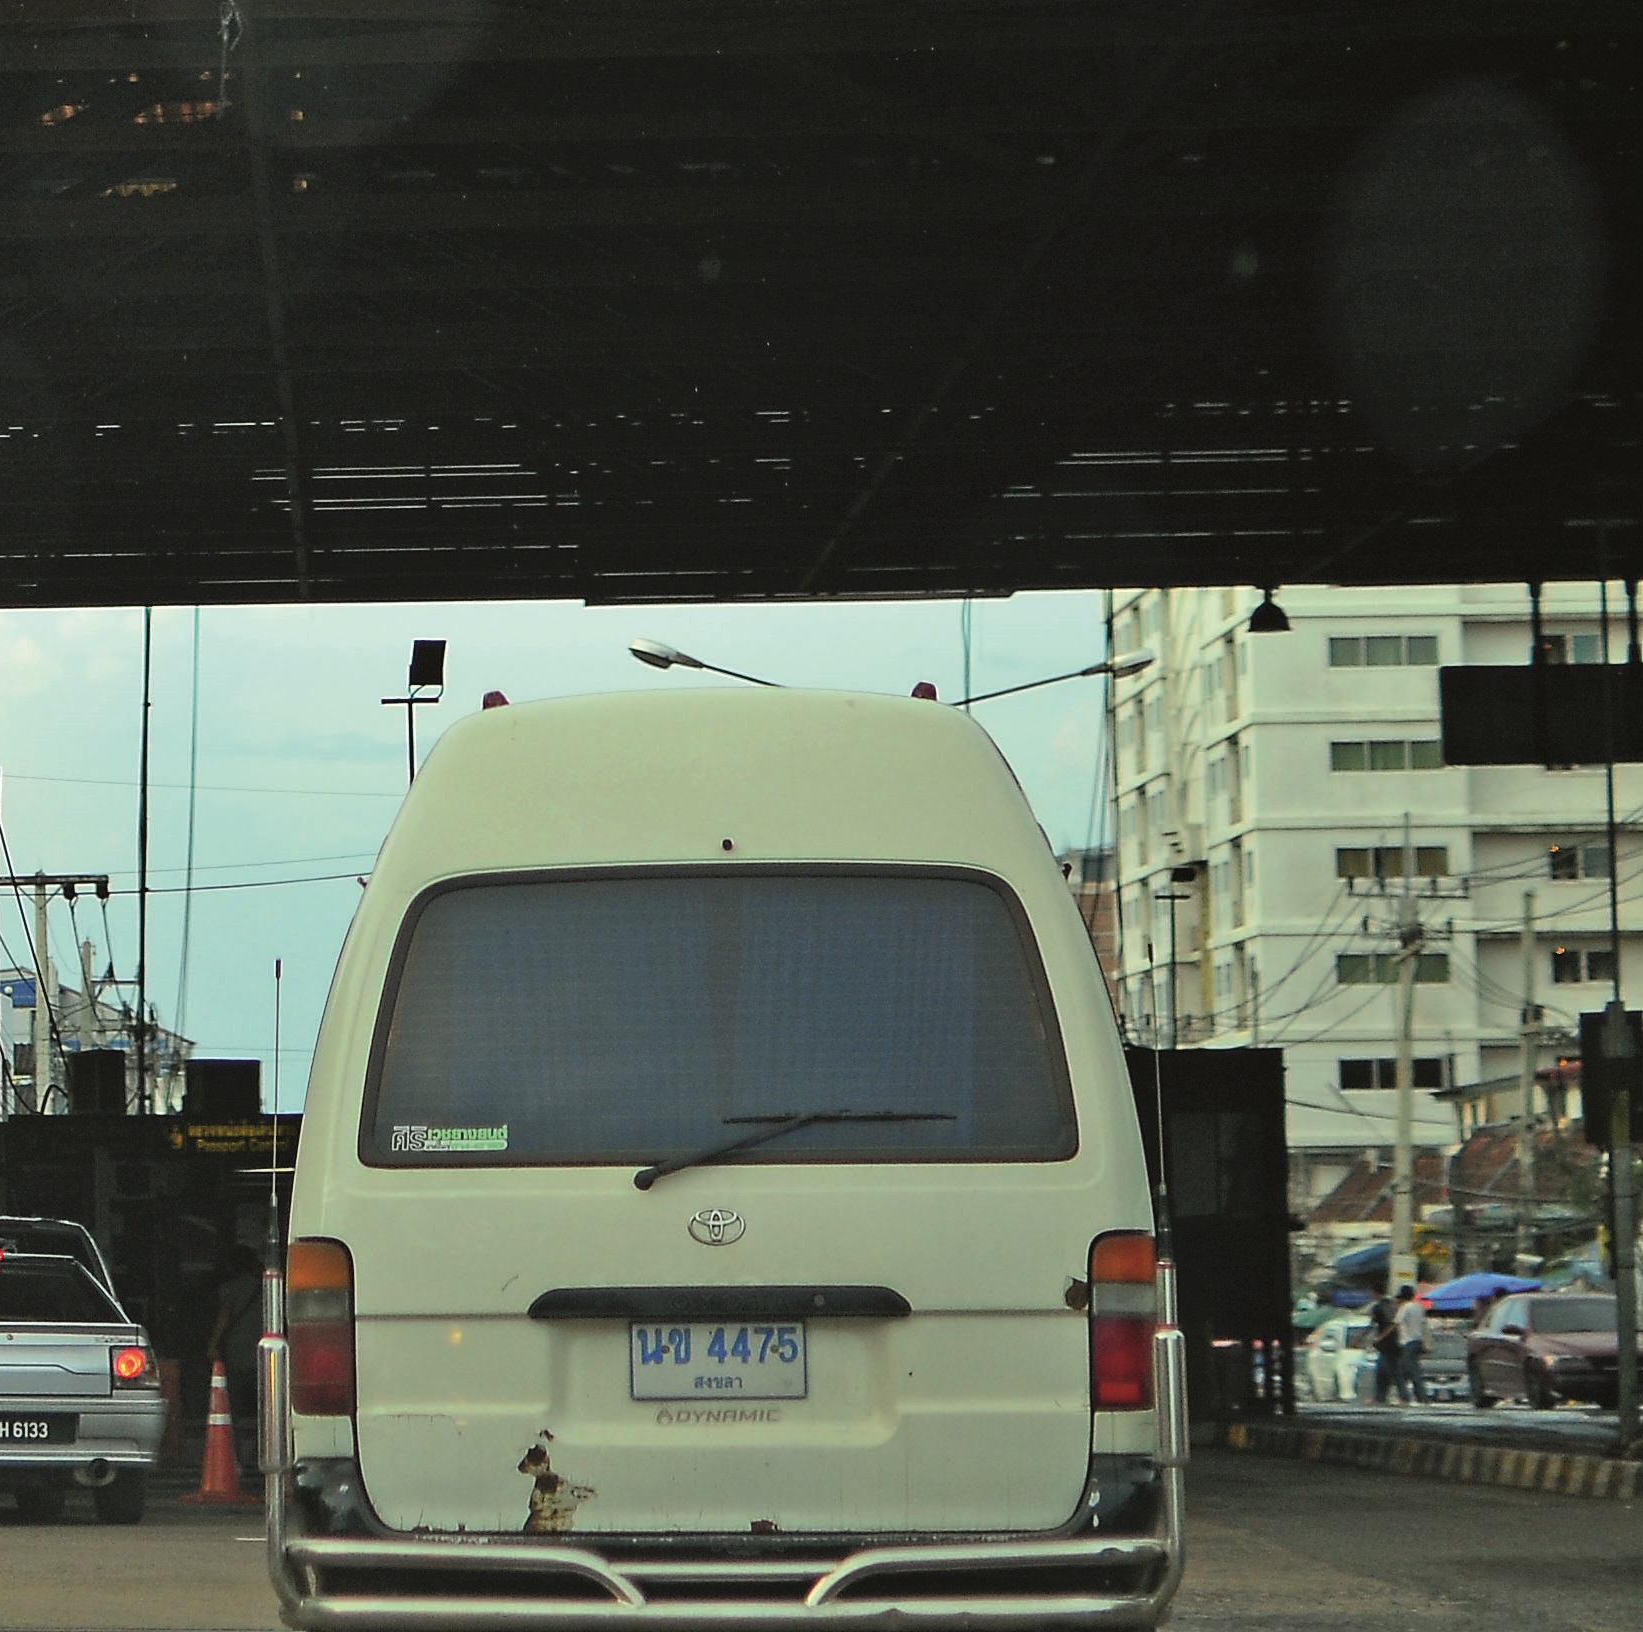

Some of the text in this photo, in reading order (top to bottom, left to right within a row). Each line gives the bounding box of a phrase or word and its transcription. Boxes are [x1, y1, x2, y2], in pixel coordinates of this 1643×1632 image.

[707, 1326, 799, 1365] 4475
[693, 1374, 744, 1390] สงขลา
[13, 1421, 49, 1438] 6133
